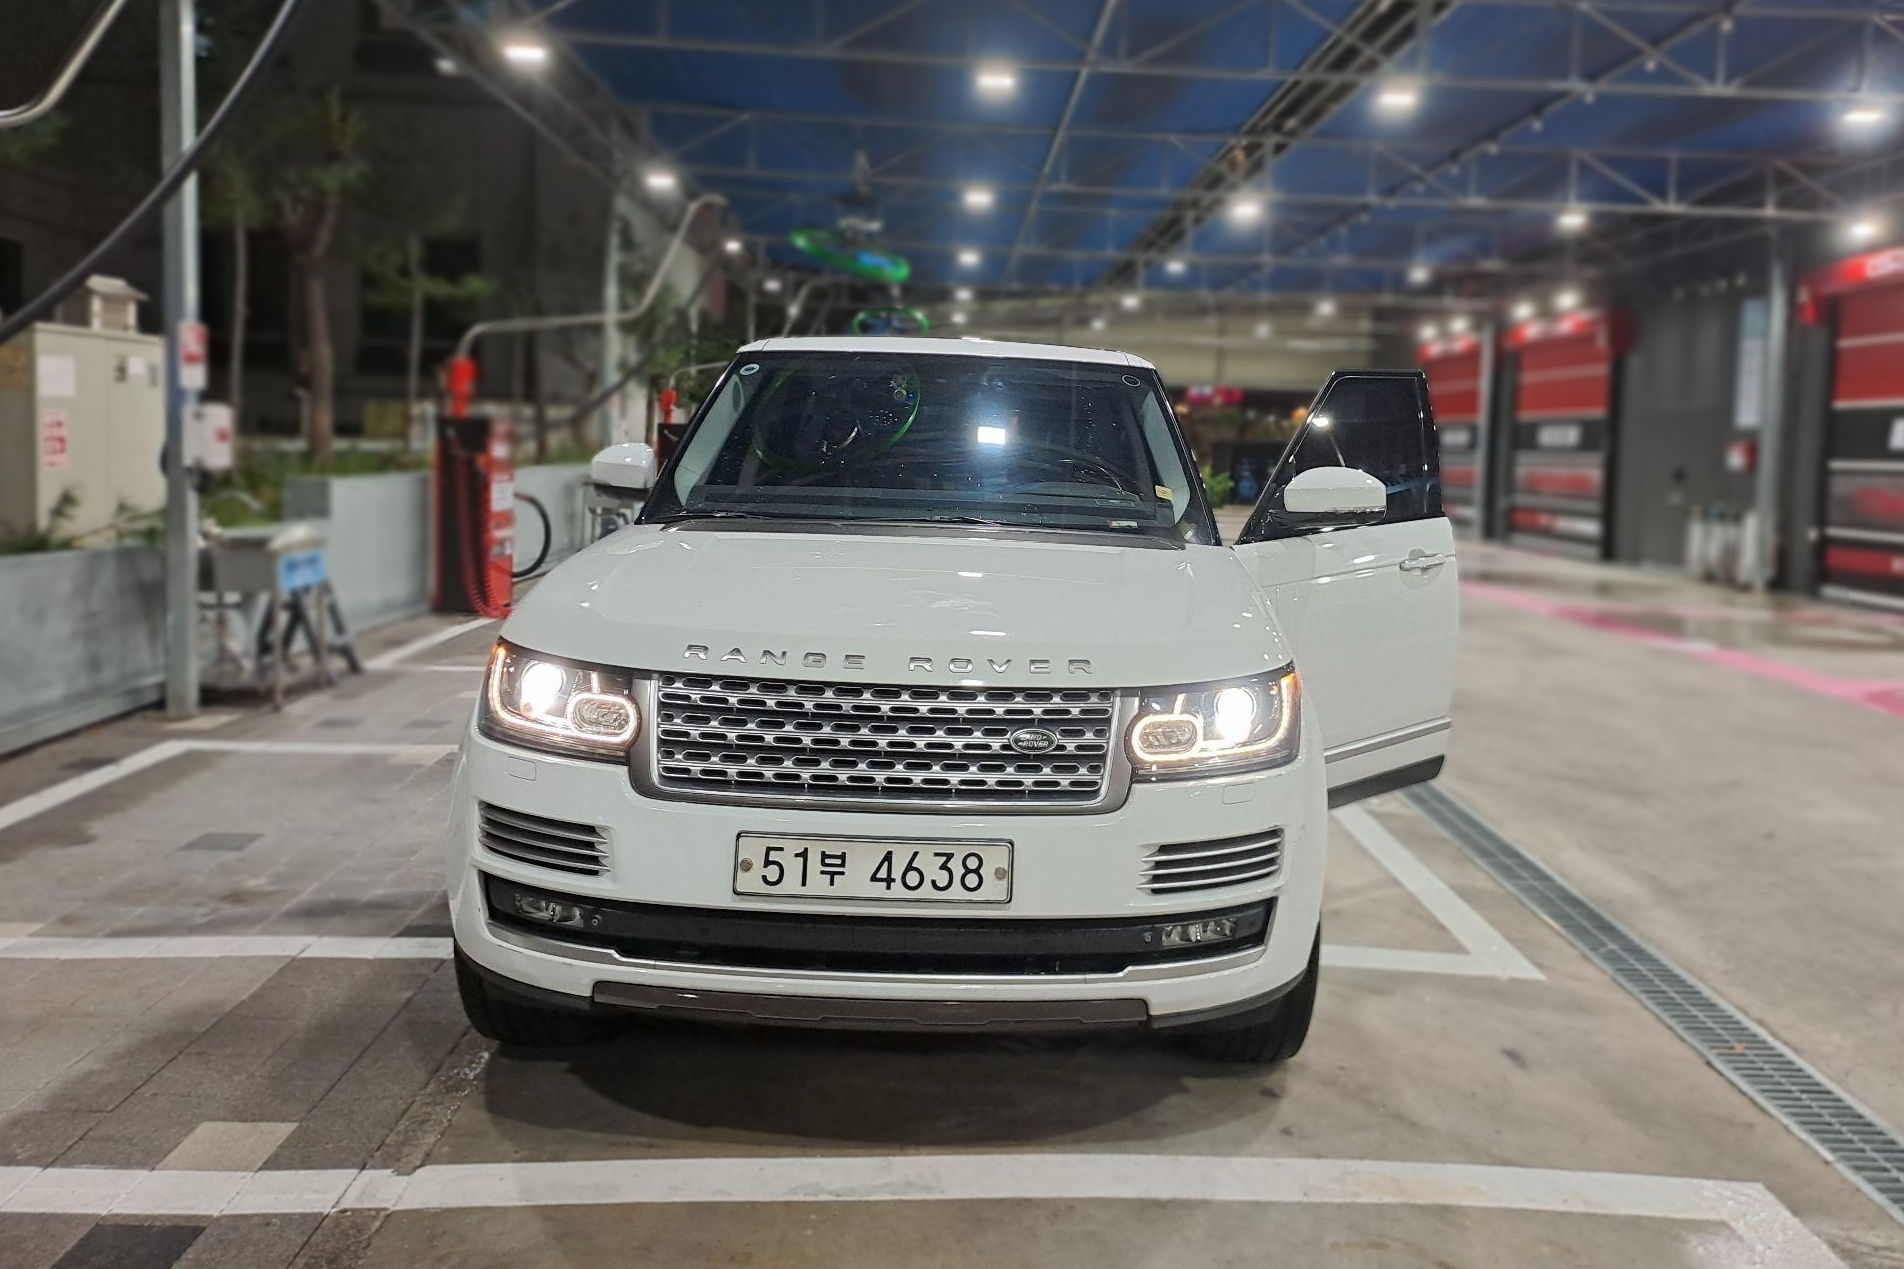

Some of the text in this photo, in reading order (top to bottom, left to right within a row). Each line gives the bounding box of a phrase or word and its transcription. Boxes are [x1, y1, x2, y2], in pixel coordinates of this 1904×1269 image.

[684, 644, 1093, 675] RANGE ROVER
[1022, 740, 1049, 748] ROVER
[761, 846, 984, 893] 51부 4638
